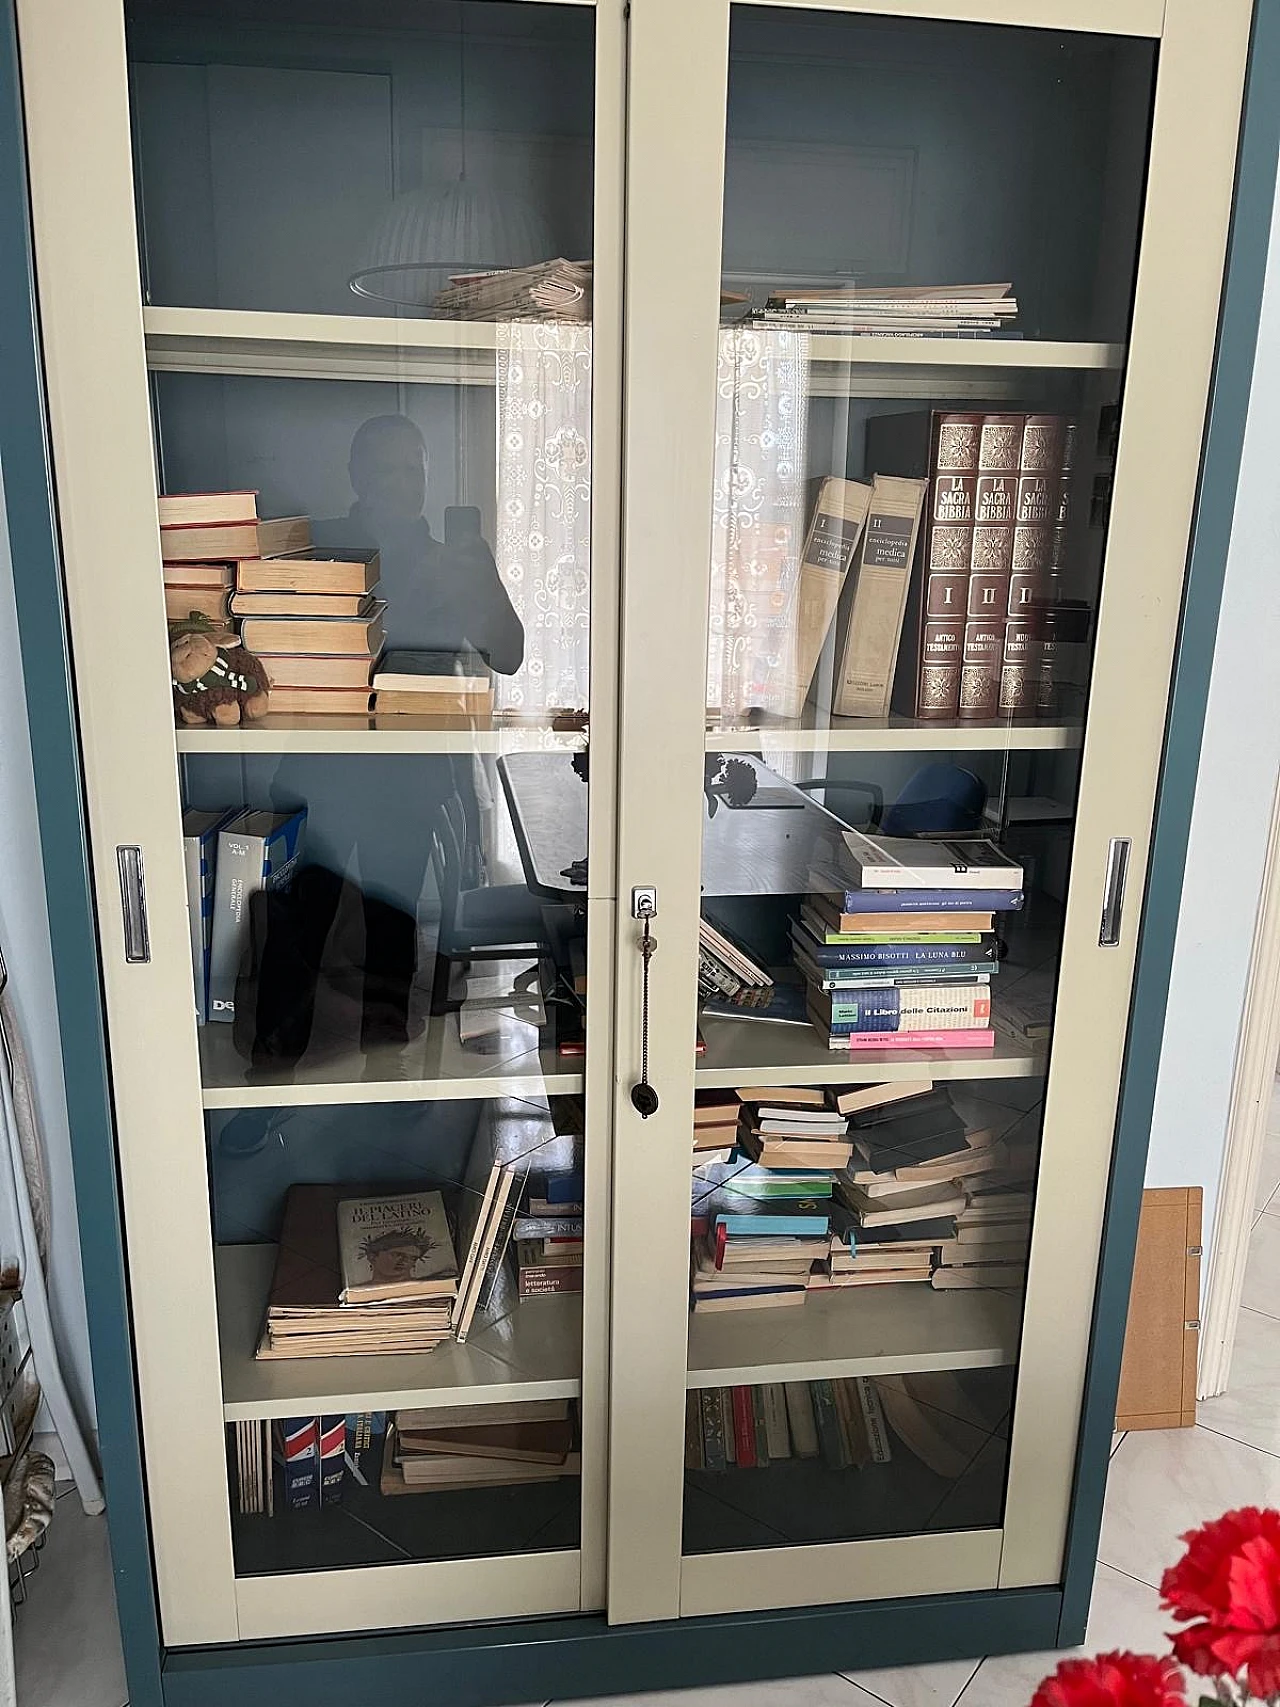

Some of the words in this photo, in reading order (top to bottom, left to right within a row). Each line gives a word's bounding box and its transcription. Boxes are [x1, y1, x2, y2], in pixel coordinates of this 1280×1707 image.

[951, 478, 964, 492] LA
[993, 479, 1005, 492] LA
[940, 491, 971, 505] SACRA
[982, 491, 1011, 506] SACRA
[938, 504, 972, 519] BIBBIA
[979, 505, 1012, 520] BIBBIA
[876, 547, 906, 558] medica
[943, 587, 953, 604] I
[981, 588, 997, 604] II
[837, 953, 876, 961] MASSIMO
[928, 951, 949, 959] LUNA
[951, 950, 967, 958] BLU
[873, 1008, 897, 1016] Libro
[900, 1007, 924, 1015] delle
[926, 1006, 968, 1014] Citazioni
[525, 1279, 560, 1288] letteratura
[306, 1447, 312, 1455] 2
